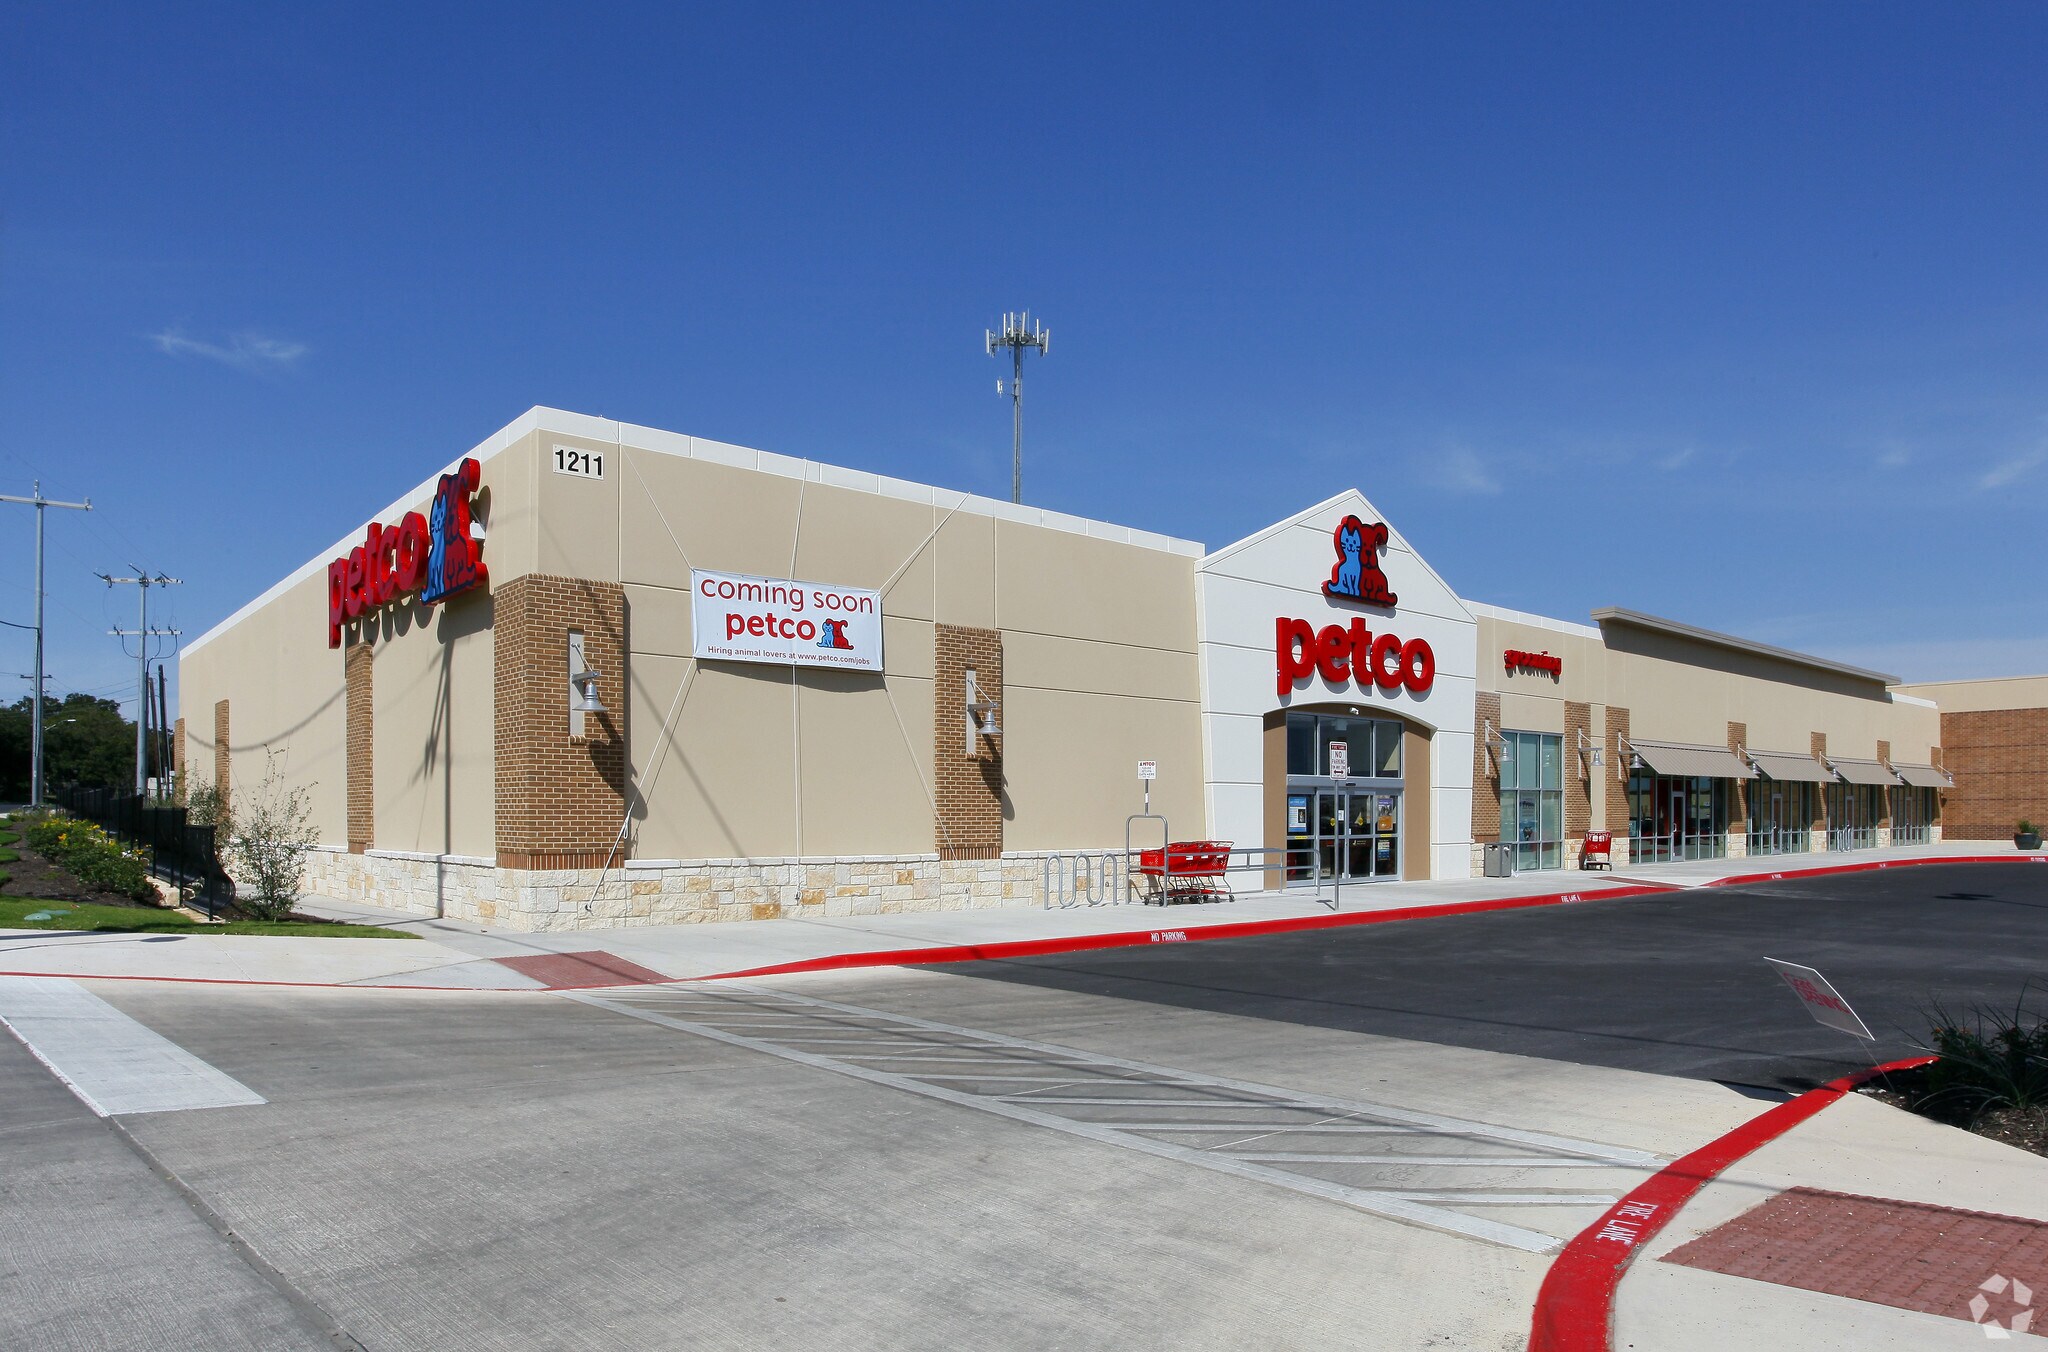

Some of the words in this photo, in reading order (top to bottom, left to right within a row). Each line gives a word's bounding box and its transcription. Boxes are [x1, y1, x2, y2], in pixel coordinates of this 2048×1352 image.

[555, 449, 602, 476] 1211
[329, 511, 429, 649] petco
[700, 579, 804, 612] coming
[813, 592, 873, 614] soon
[725, 612, 817, 641] petco
[707, 645, 733, 656] Hiring
[734, 648, 761, 657] animal
[763, 650, 787, 659] lovers
[797, 653, 871, 665] www.petco.com/jobs
[1275, 616, 1436, 696] petco
[1334, 751, 1343, 759] NO
[1150, 932, 1160, 942] NO
[1161, 931, 1187, 942] PARKING
[1616, 1200, 1659, 1219] FIRE
[1595, 1219, 1642, 1245] LANE
